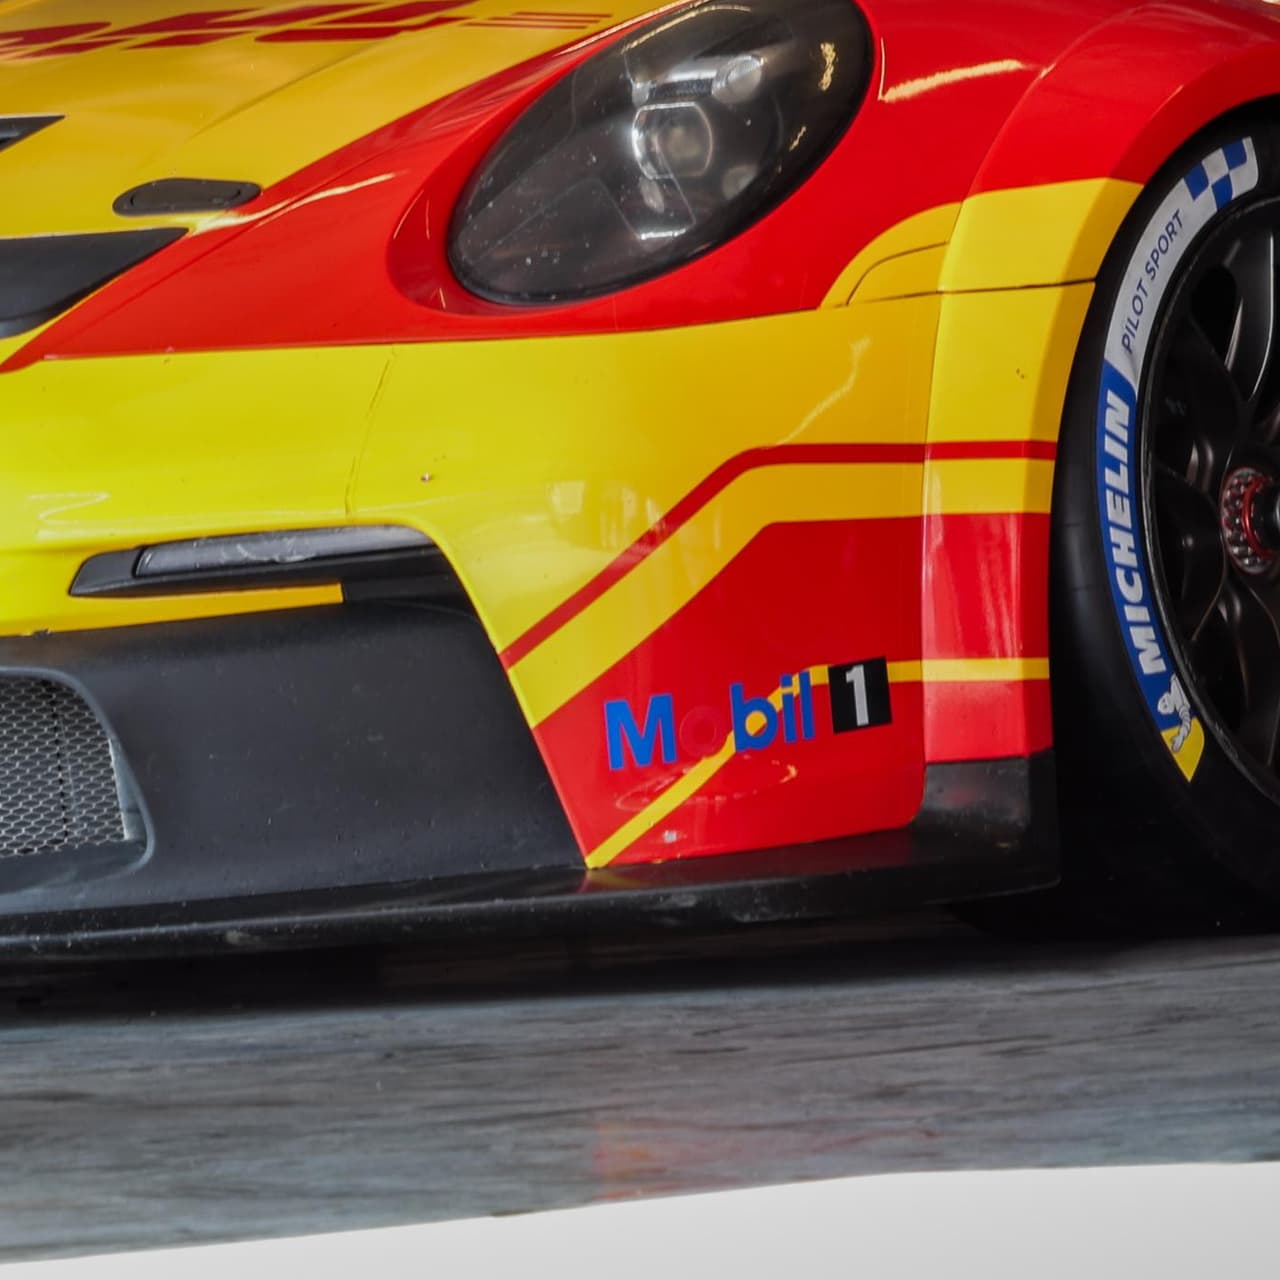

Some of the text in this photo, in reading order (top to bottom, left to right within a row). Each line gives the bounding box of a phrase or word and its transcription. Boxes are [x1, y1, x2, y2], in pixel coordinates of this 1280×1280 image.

[1121, 210, 1185, 355] PILOT SPORT
[1102, 391, 1166, 675] MICHELIN
[845, 664, 870, 727] 1
